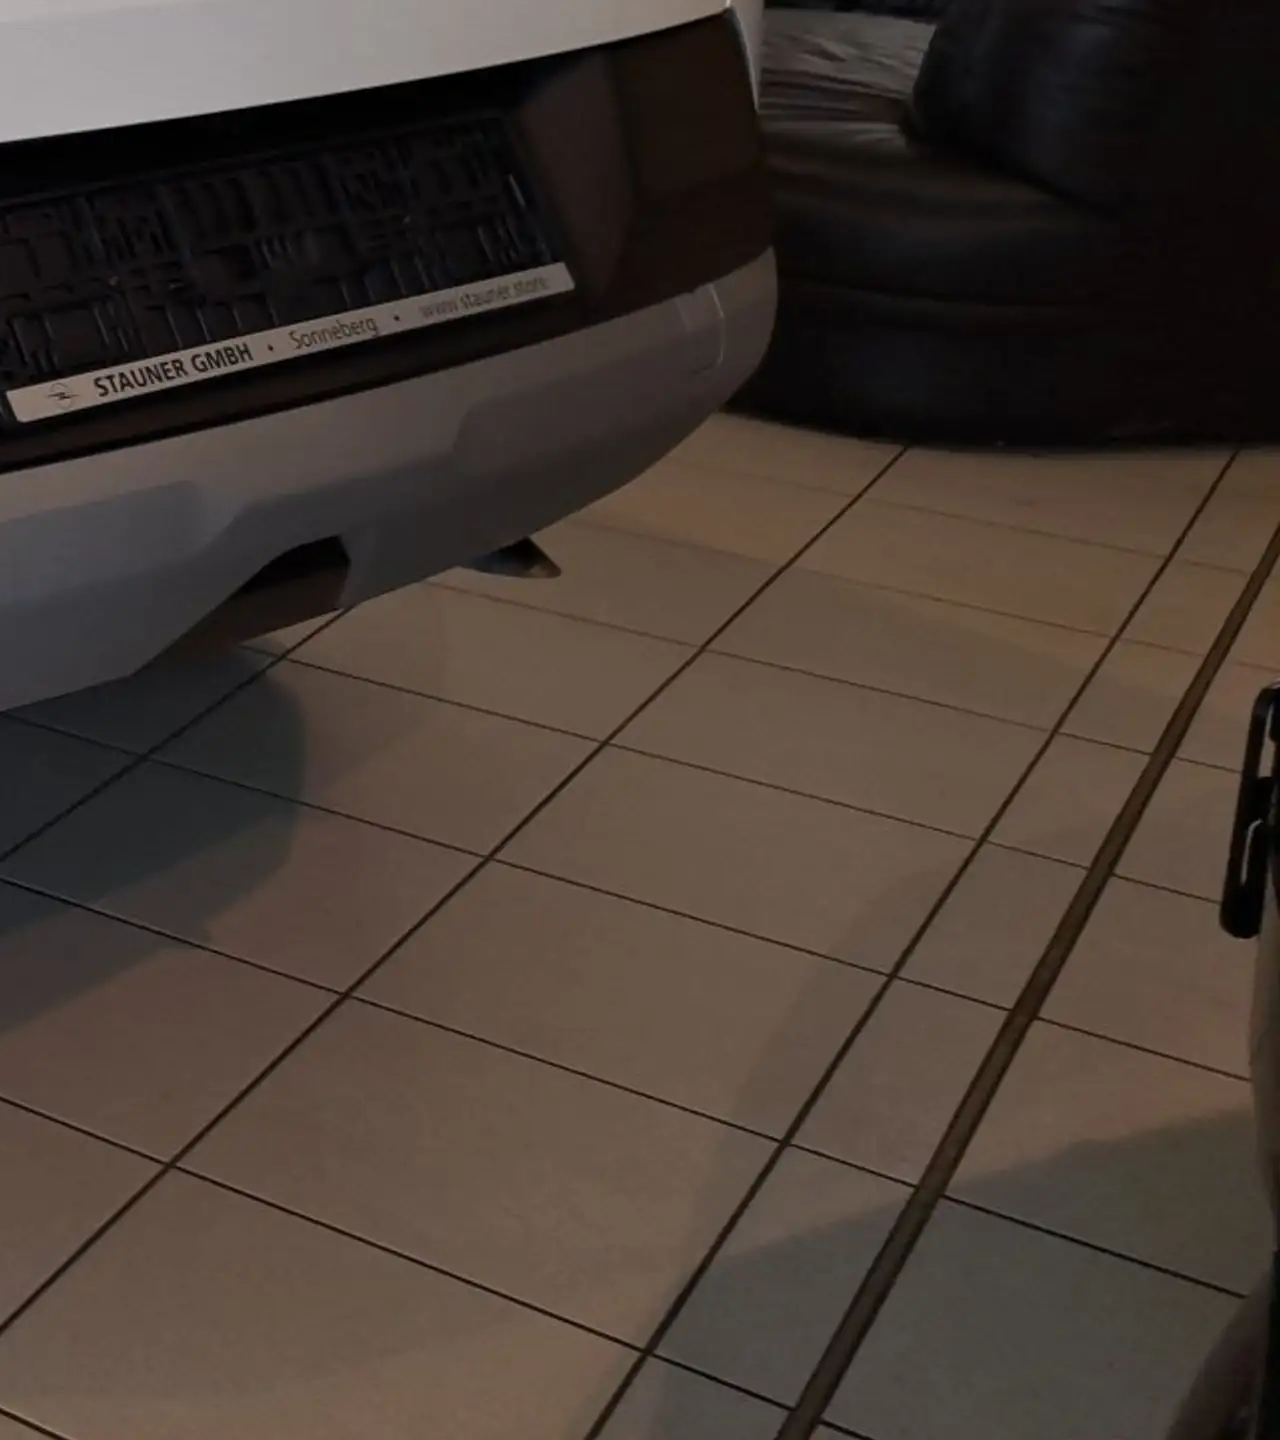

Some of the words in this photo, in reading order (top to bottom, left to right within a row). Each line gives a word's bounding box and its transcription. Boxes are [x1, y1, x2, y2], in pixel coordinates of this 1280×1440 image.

[93, 359, 189, 397] STAUNER
[190, 343, 254, 373] GMBH
[288, 318, 379, 350] Sonneberg
